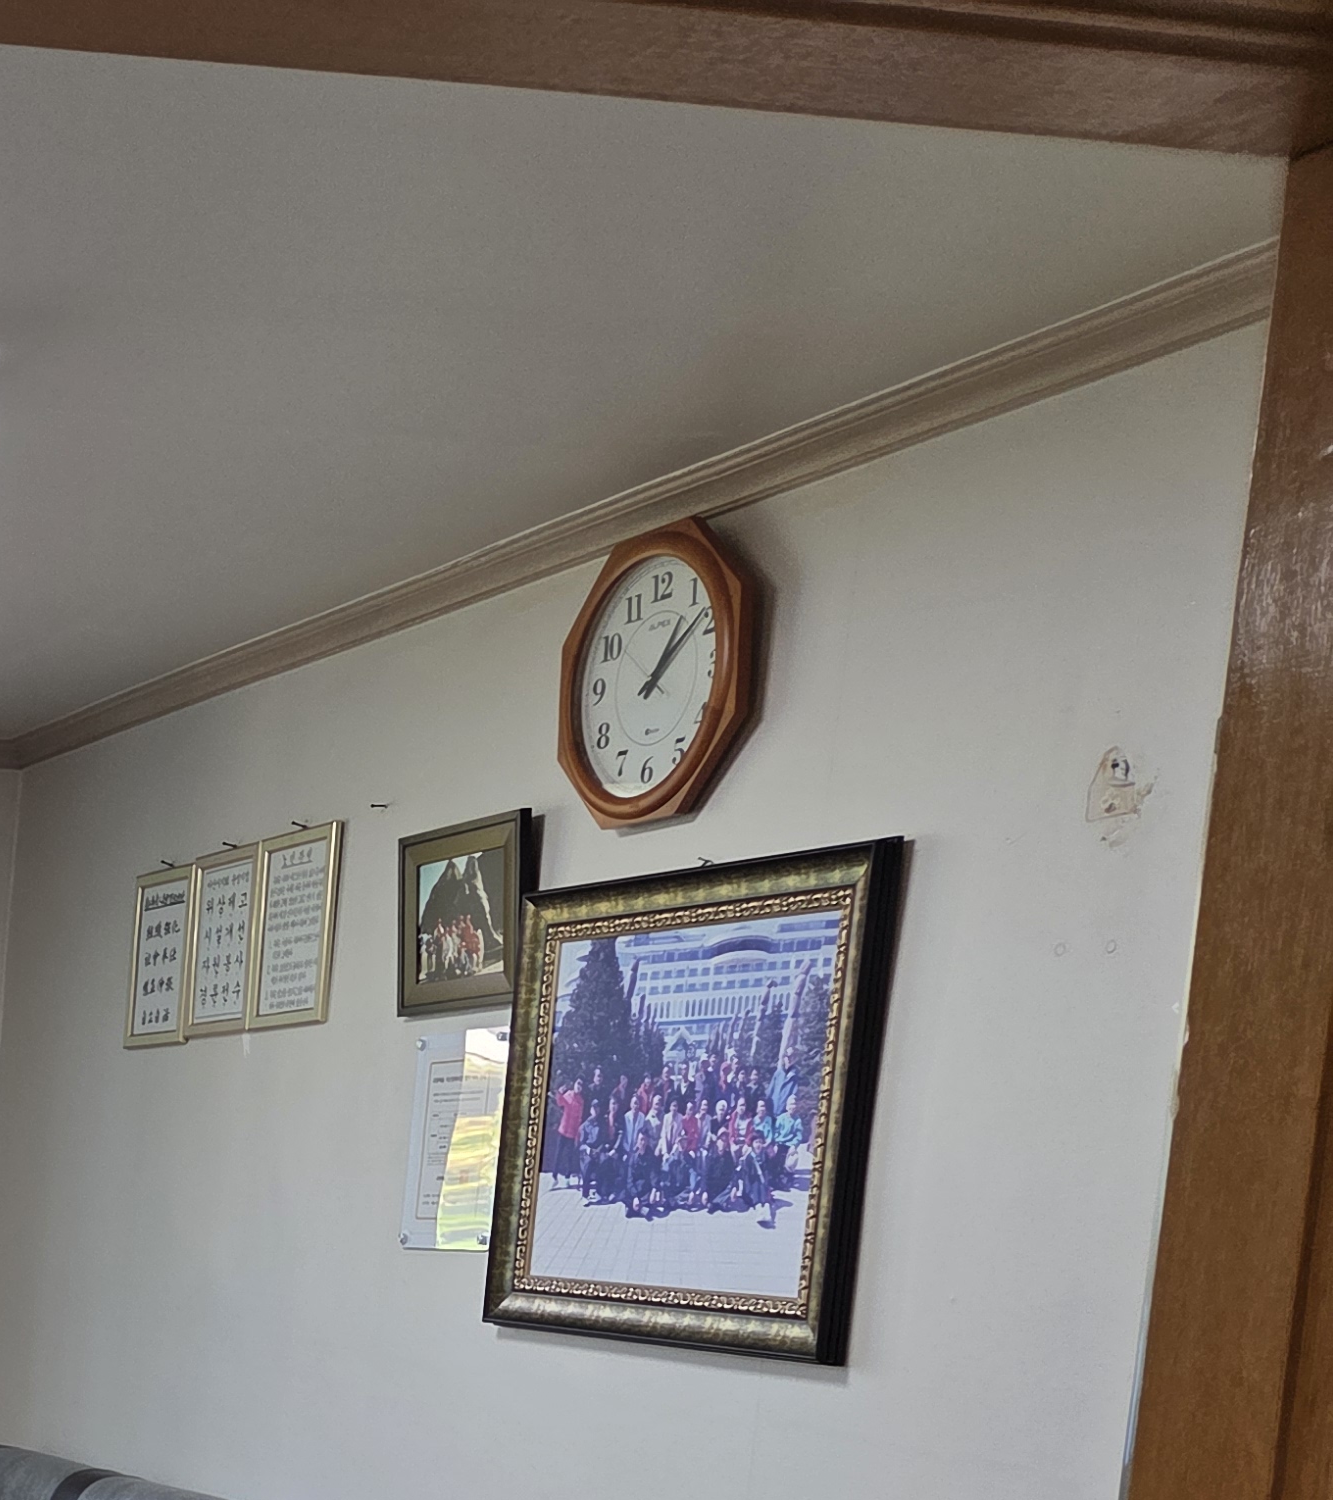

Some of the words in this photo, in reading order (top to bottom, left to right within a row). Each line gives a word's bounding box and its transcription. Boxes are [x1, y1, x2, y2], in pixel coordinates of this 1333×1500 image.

[651, 571, 673, 603] 12
[688, 578, 698, 608] 1
[624, 594, 643, 624] 11
[702, 606, 716, 635] 2
[600, 633, 621, 663] 10
[593, 678, 606, 706] 9
[597, 723, 610, 749] 8
[672, 736, 686, 765] 5
[616, 750, 628, 777] 7
[641, 756, 653, 784] 6
